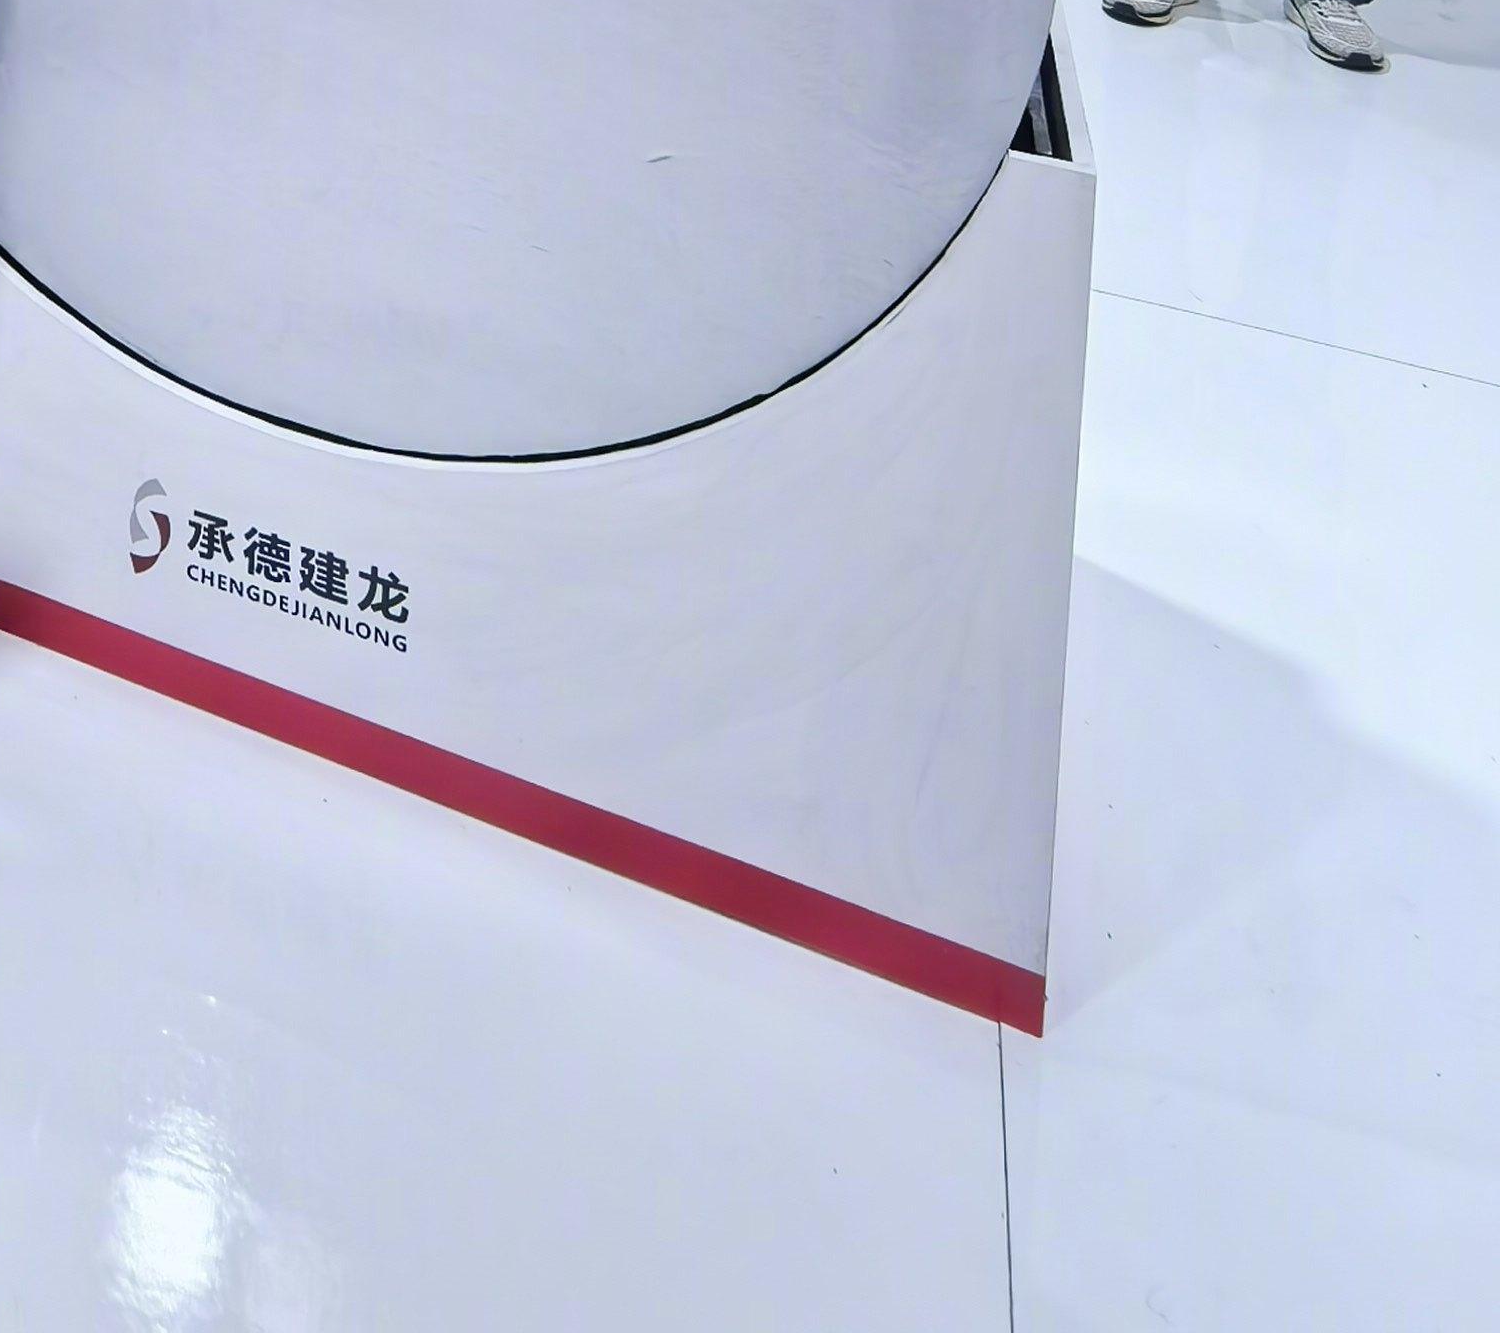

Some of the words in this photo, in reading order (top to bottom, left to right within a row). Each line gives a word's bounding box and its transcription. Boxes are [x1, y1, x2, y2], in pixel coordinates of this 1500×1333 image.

[186, 563, 408, 653] CHENGDEJIANLONG
[187, 509, 410, 624] 承德建龙
